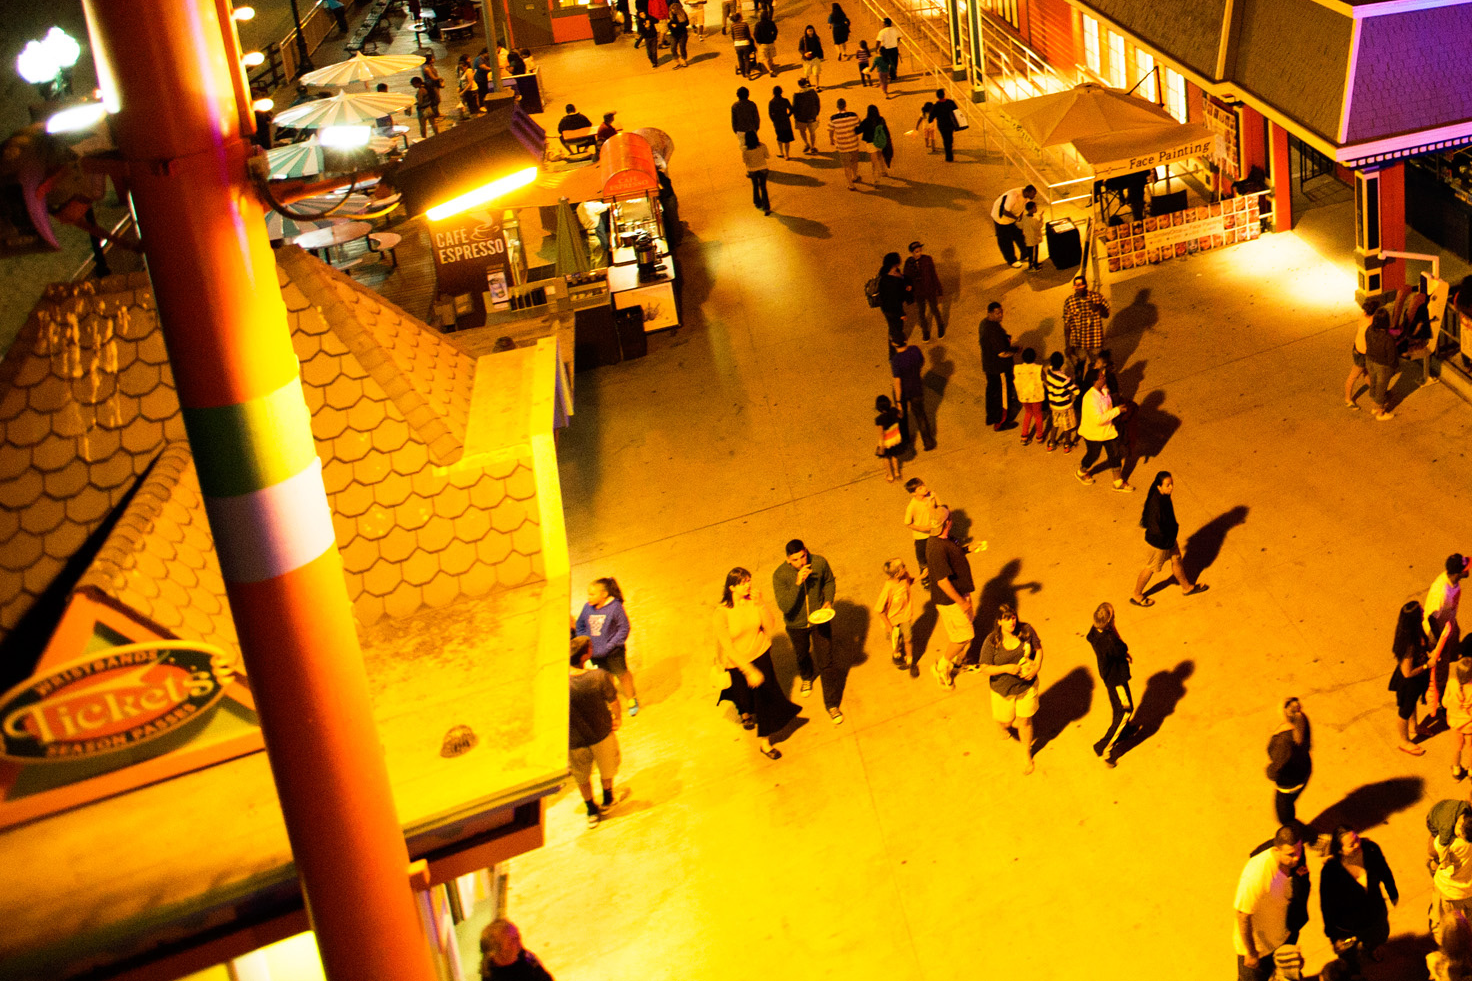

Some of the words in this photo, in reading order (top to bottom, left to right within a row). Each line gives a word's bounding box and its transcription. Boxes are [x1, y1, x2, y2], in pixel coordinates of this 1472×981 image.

[1129, 156, 1154, 170] Face
[1158, 141, 1211, 162] Painting
[436, 226, 470, 248] CAFÉ
[438, 238, 505, 265] ESPRESSO
[34, 649, 158, 696] WRISTBANDS
[3, 661, 214, 744] Tickets
[47, 733, 127, 757] SEASON
[133, 703, 198, 740] PASSES
